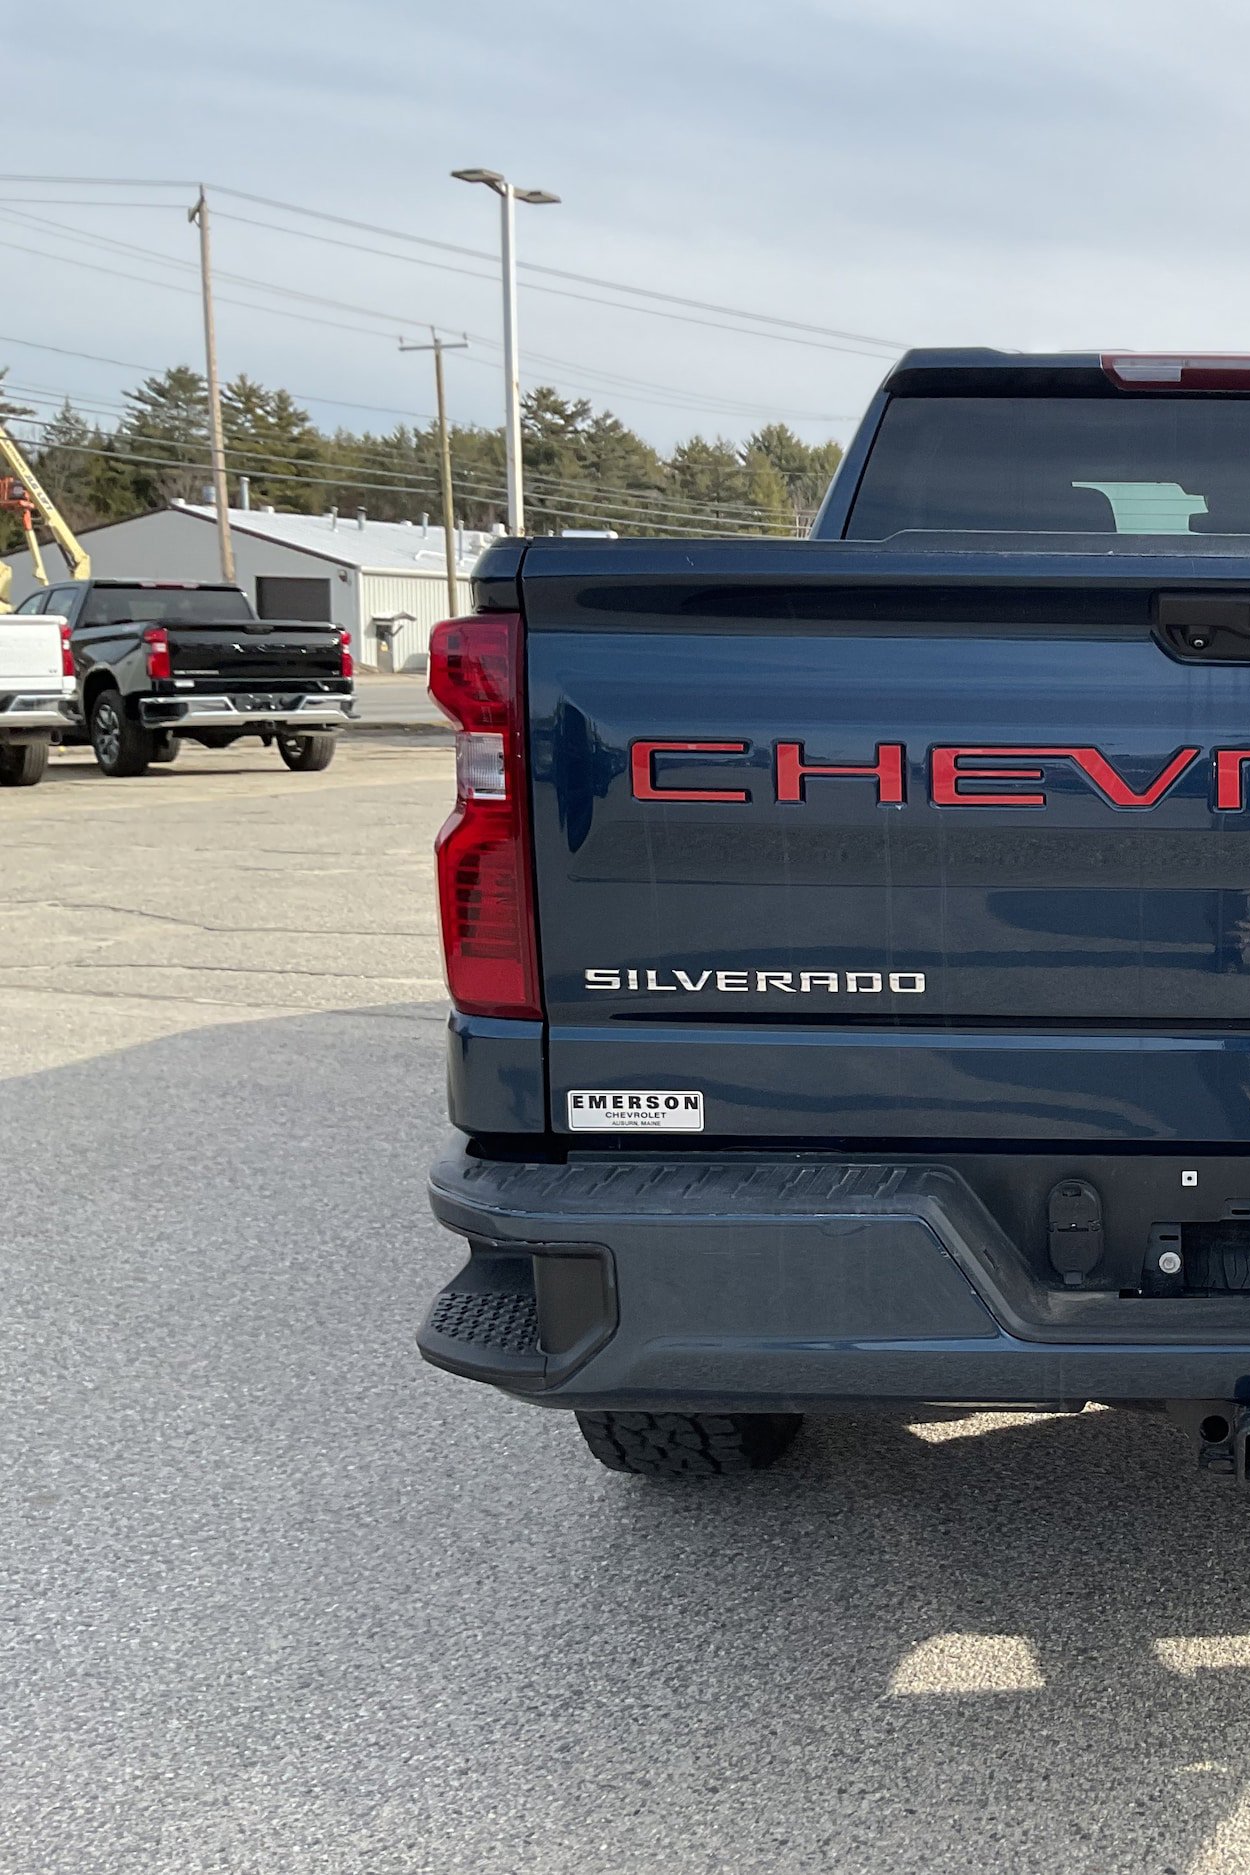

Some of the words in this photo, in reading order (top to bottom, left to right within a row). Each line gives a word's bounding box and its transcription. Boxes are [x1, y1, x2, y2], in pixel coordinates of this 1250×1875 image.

[584, 968, 926, 993] SILVERADO
[572, 1095, 699, 1110] EMERSON
[605, 1111, 667, 1119] CHEVROLET
